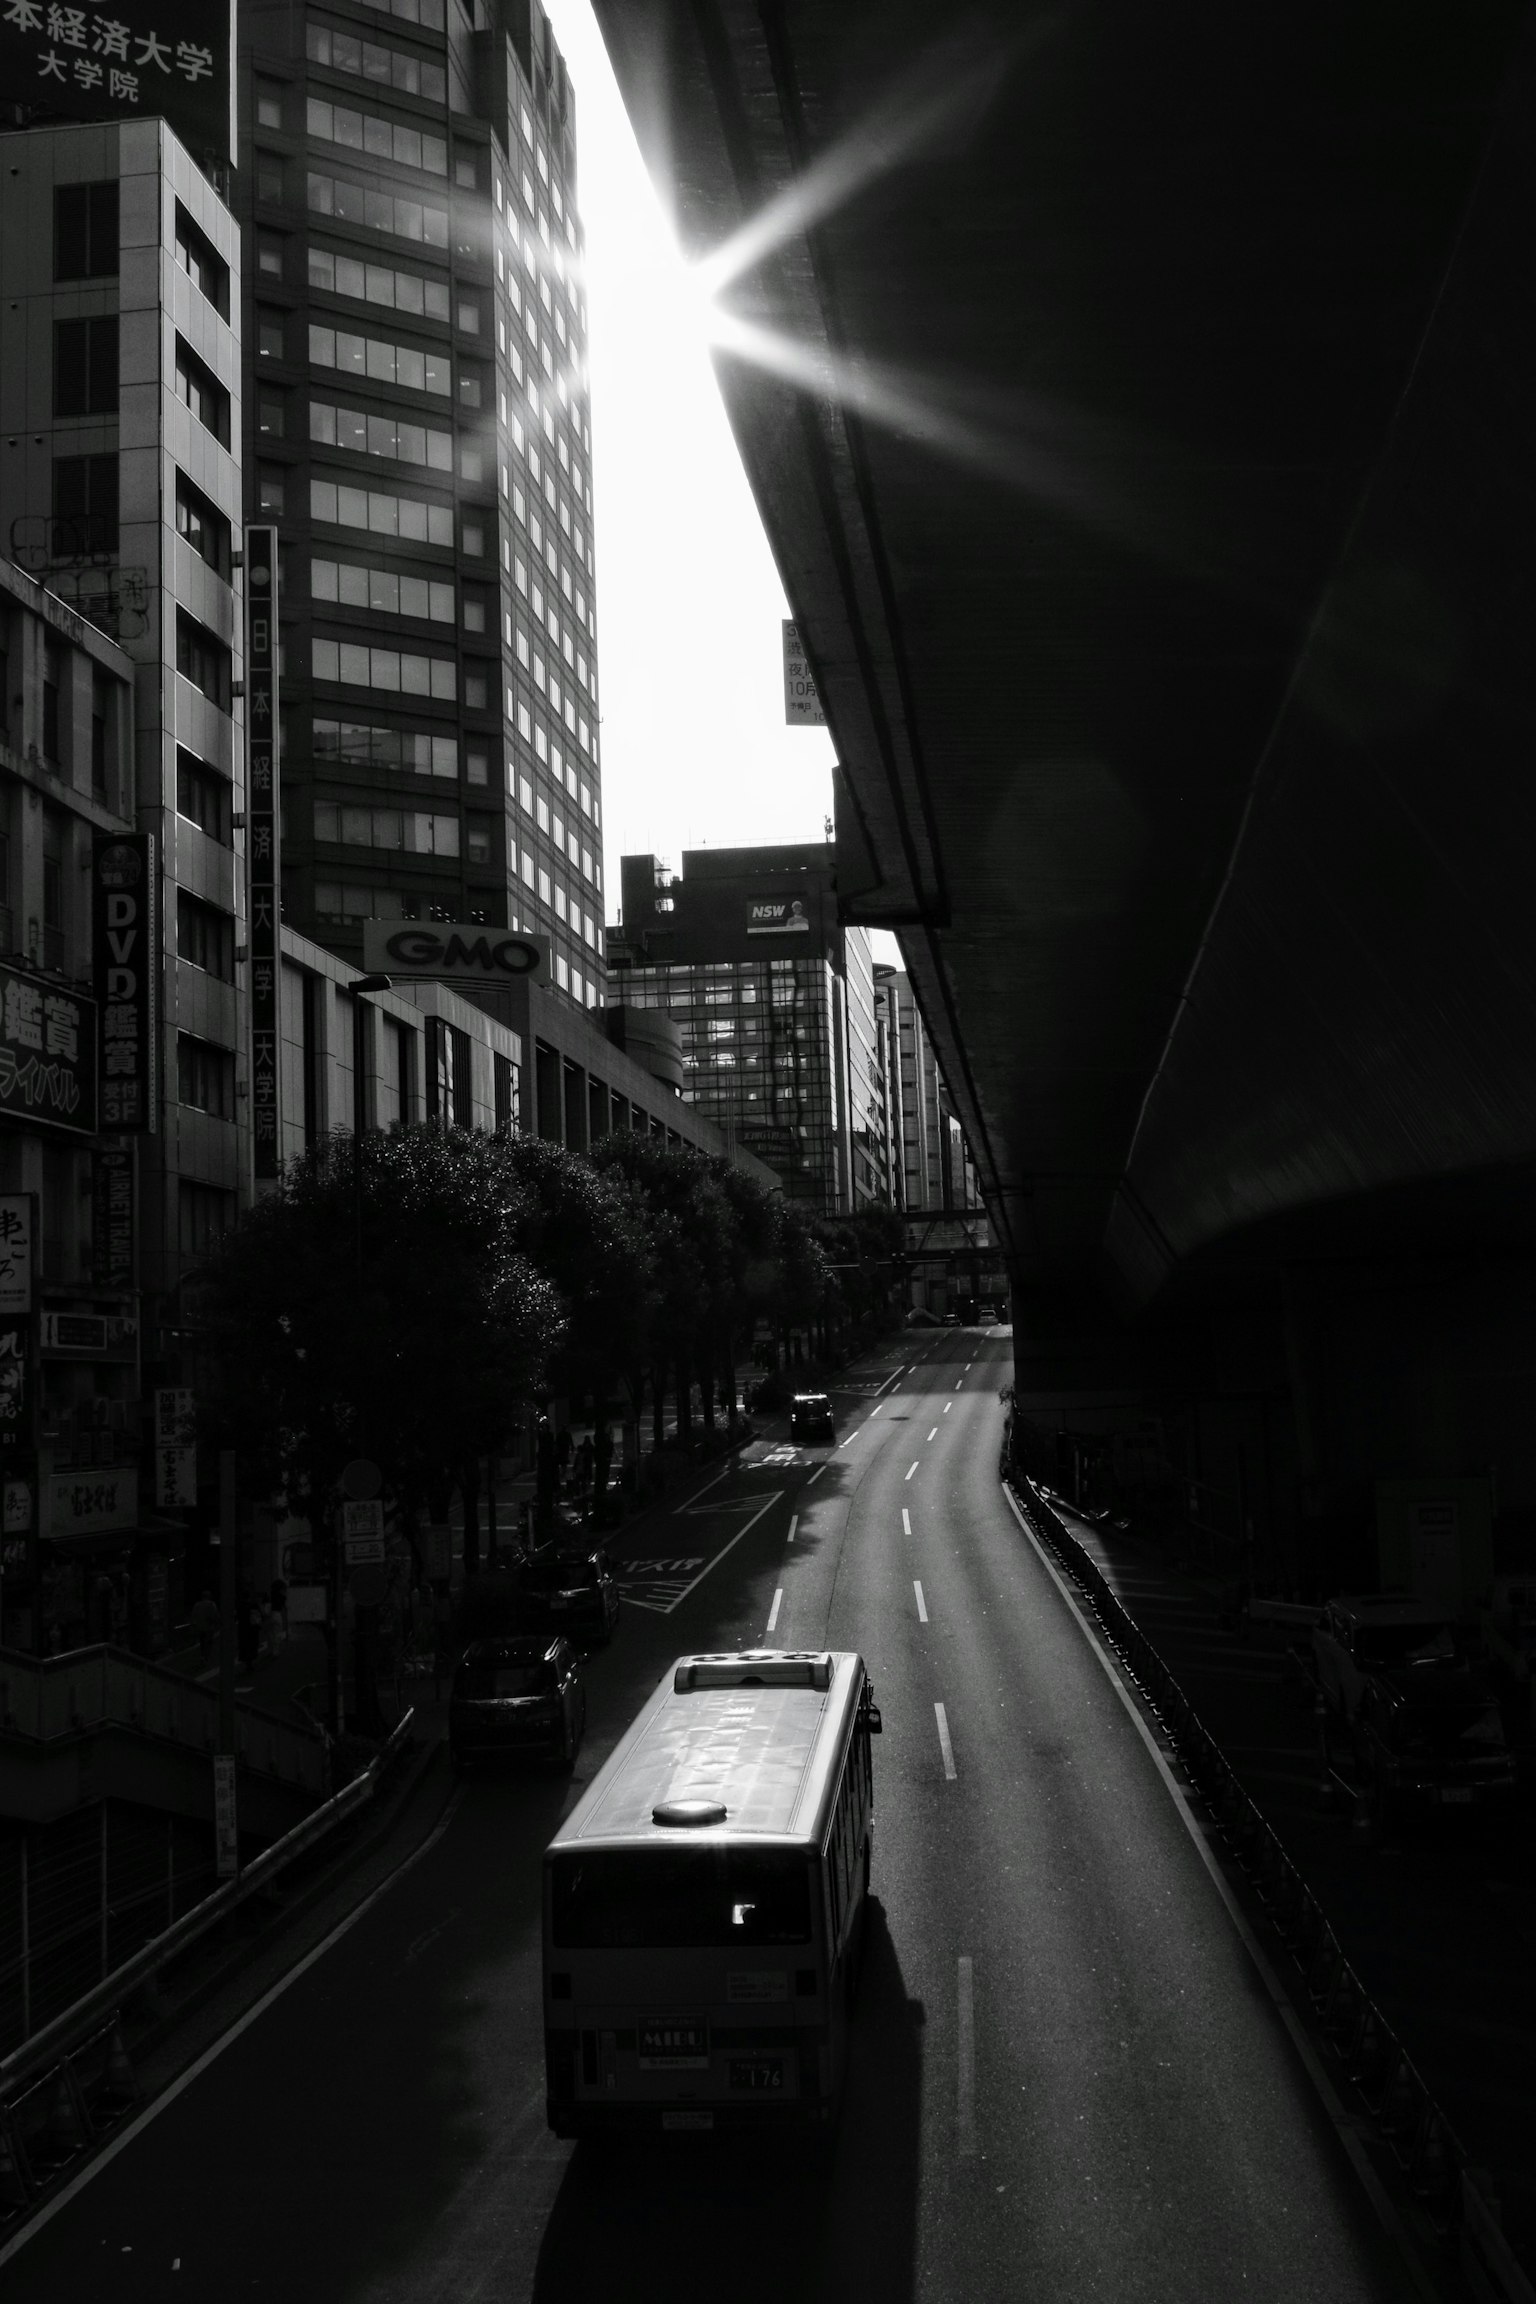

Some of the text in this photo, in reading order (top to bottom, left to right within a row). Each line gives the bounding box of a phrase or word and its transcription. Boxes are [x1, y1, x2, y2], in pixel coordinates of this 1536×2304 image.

[2, 0, 214, 82] 本経済大学
[37, 49, 139, 102] 大学院
[252, 618, 276, 1141] 日本経済大学大学院
[752, 905, 786, 918] NSW
[386, 931, 540, 974] GMO
[104, 1082, 138, 1099] 受付
[105, 1102, 137, 1121] 3F
[109, 1169, 131, 1216] AIRNET
